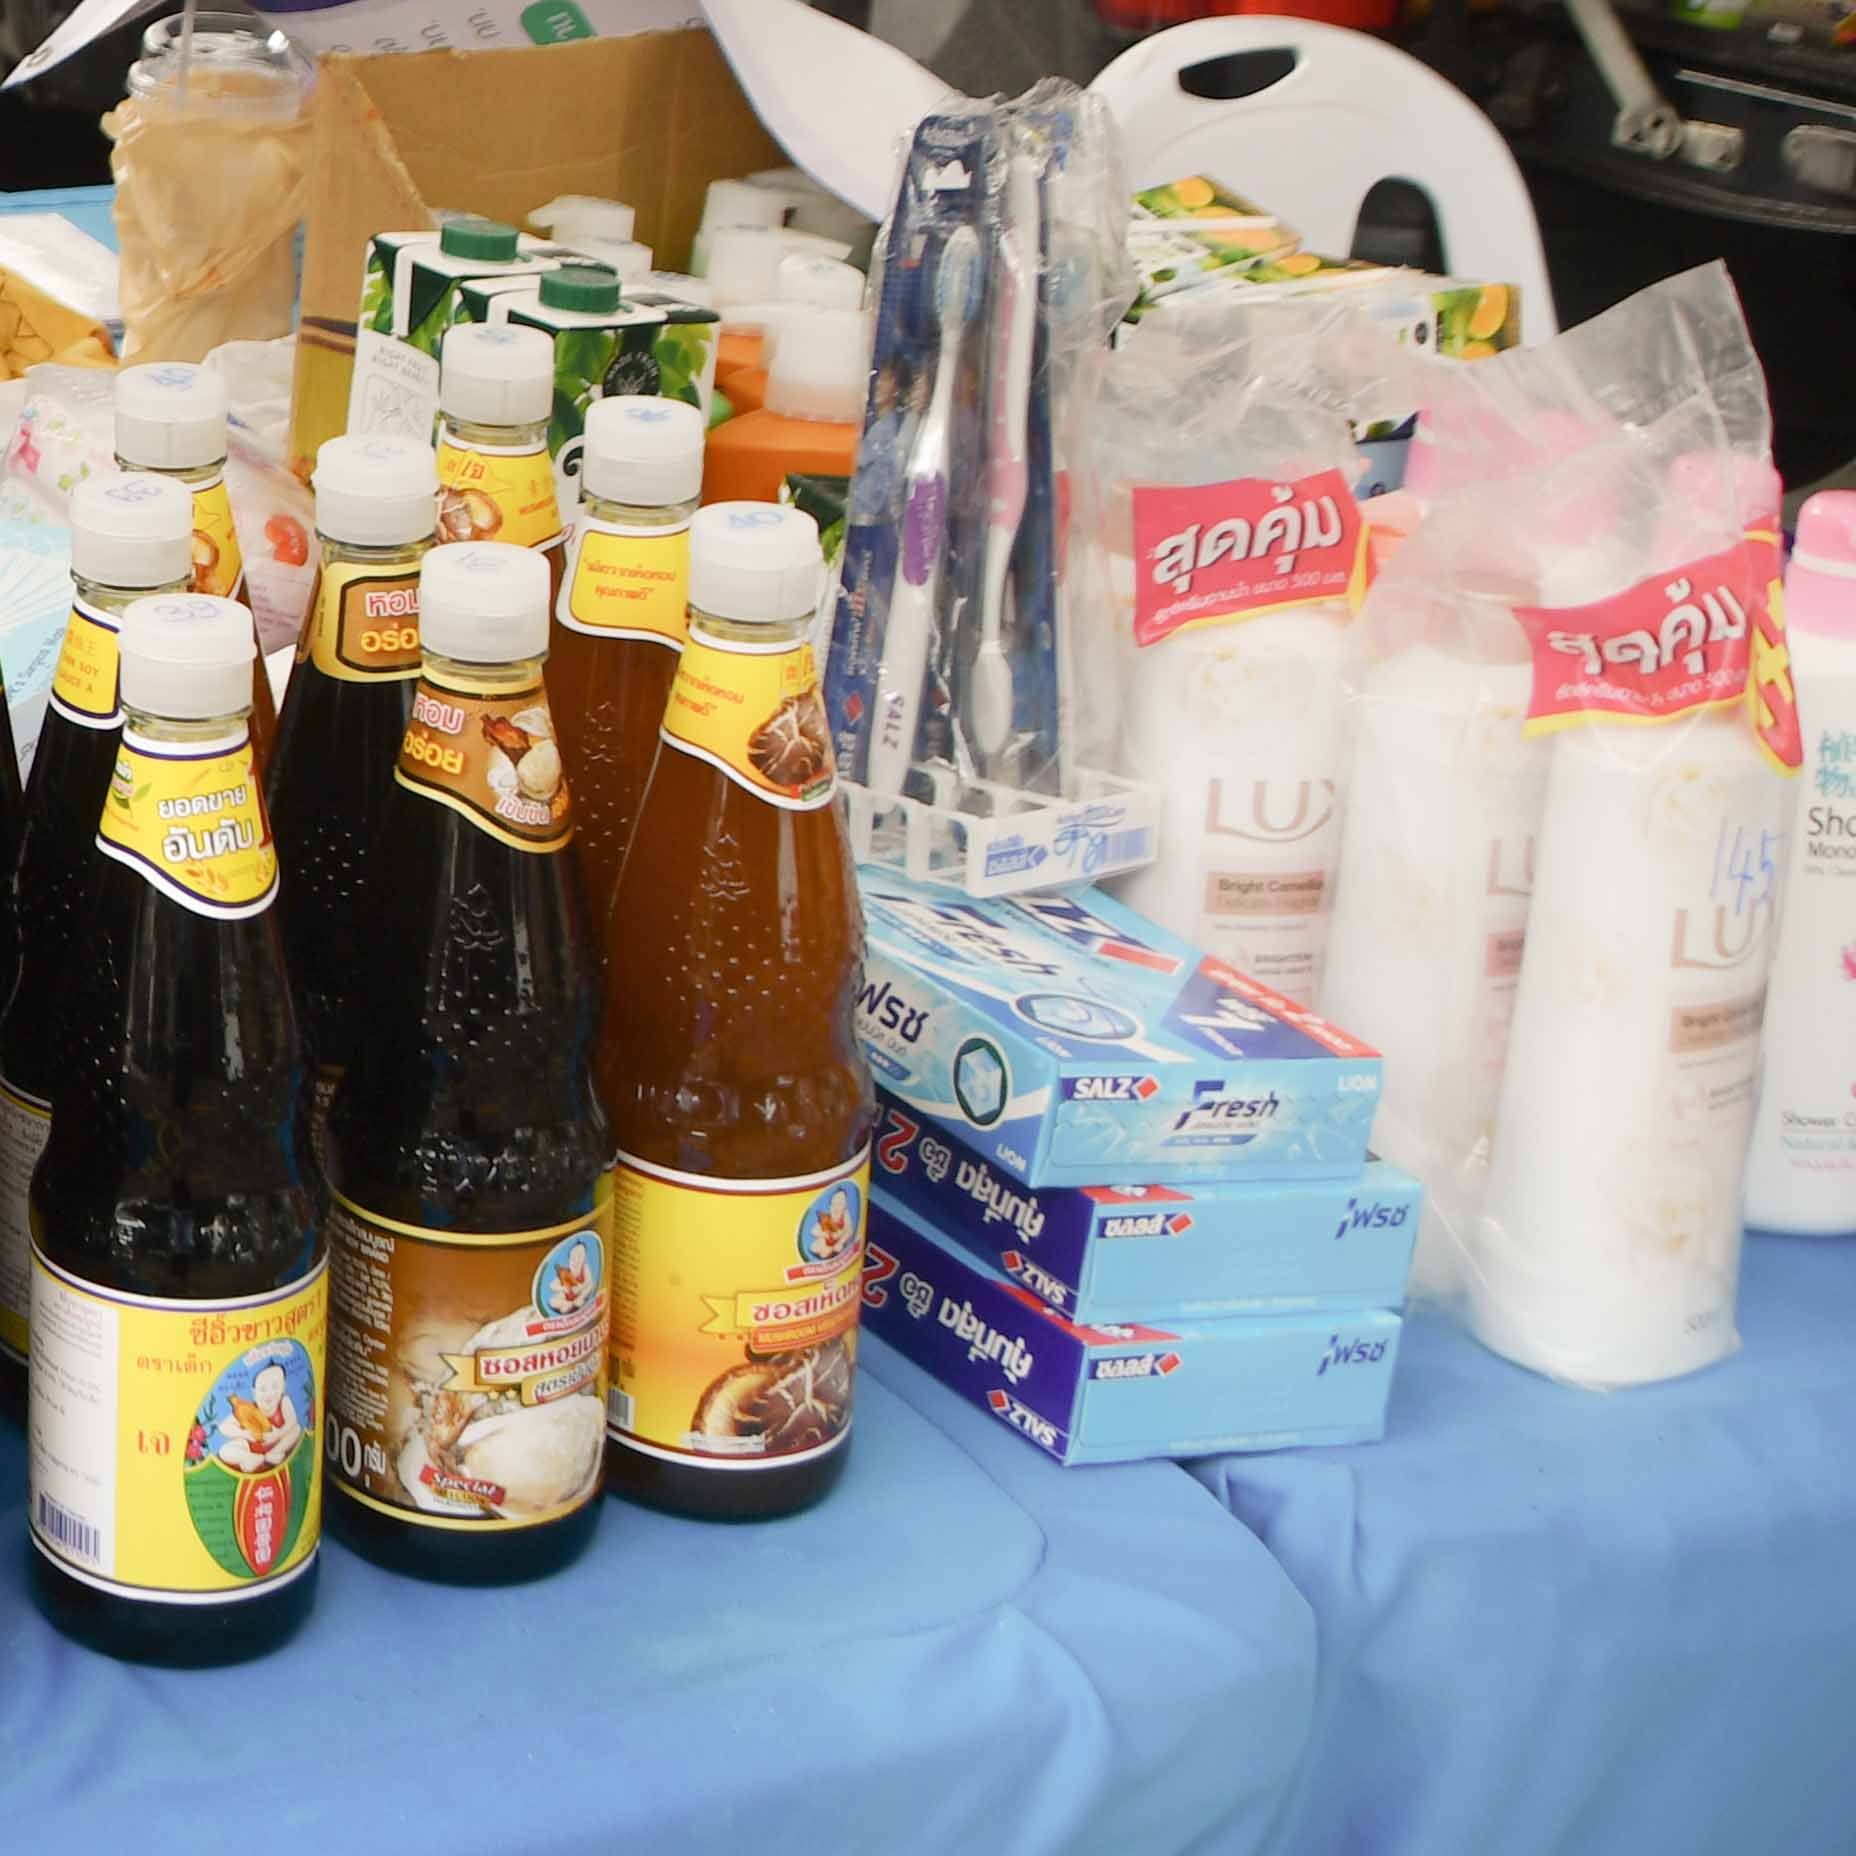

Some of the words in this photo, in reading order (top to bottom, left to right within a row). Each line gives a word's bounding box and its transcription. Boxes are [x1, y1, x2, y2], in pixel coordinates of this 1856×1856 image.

[1152, 486, 1342, 595] สุดคุ้ม
[157, 783, 247, 819] ยอดขาย
[163, 817, 255, 864] อันดับ
[1073, 1076, 1132, 1100] SALZ
[1173, 1080, 1280, 1131] Fresh
[876, 1112, 919, 1175] 2
[954, 1160, 1046, 1246] คุ้มที่สุด
[861, 1241, 898, 1309] 2
[898, 1270, 935, 1321] ซื้อ
[1021, 1265, 1068, 1307] SALZ
[936, 1299, 1035, 1386] คุ้มที่สุด
[1008, 1402, 1058, 1448] SALZ
